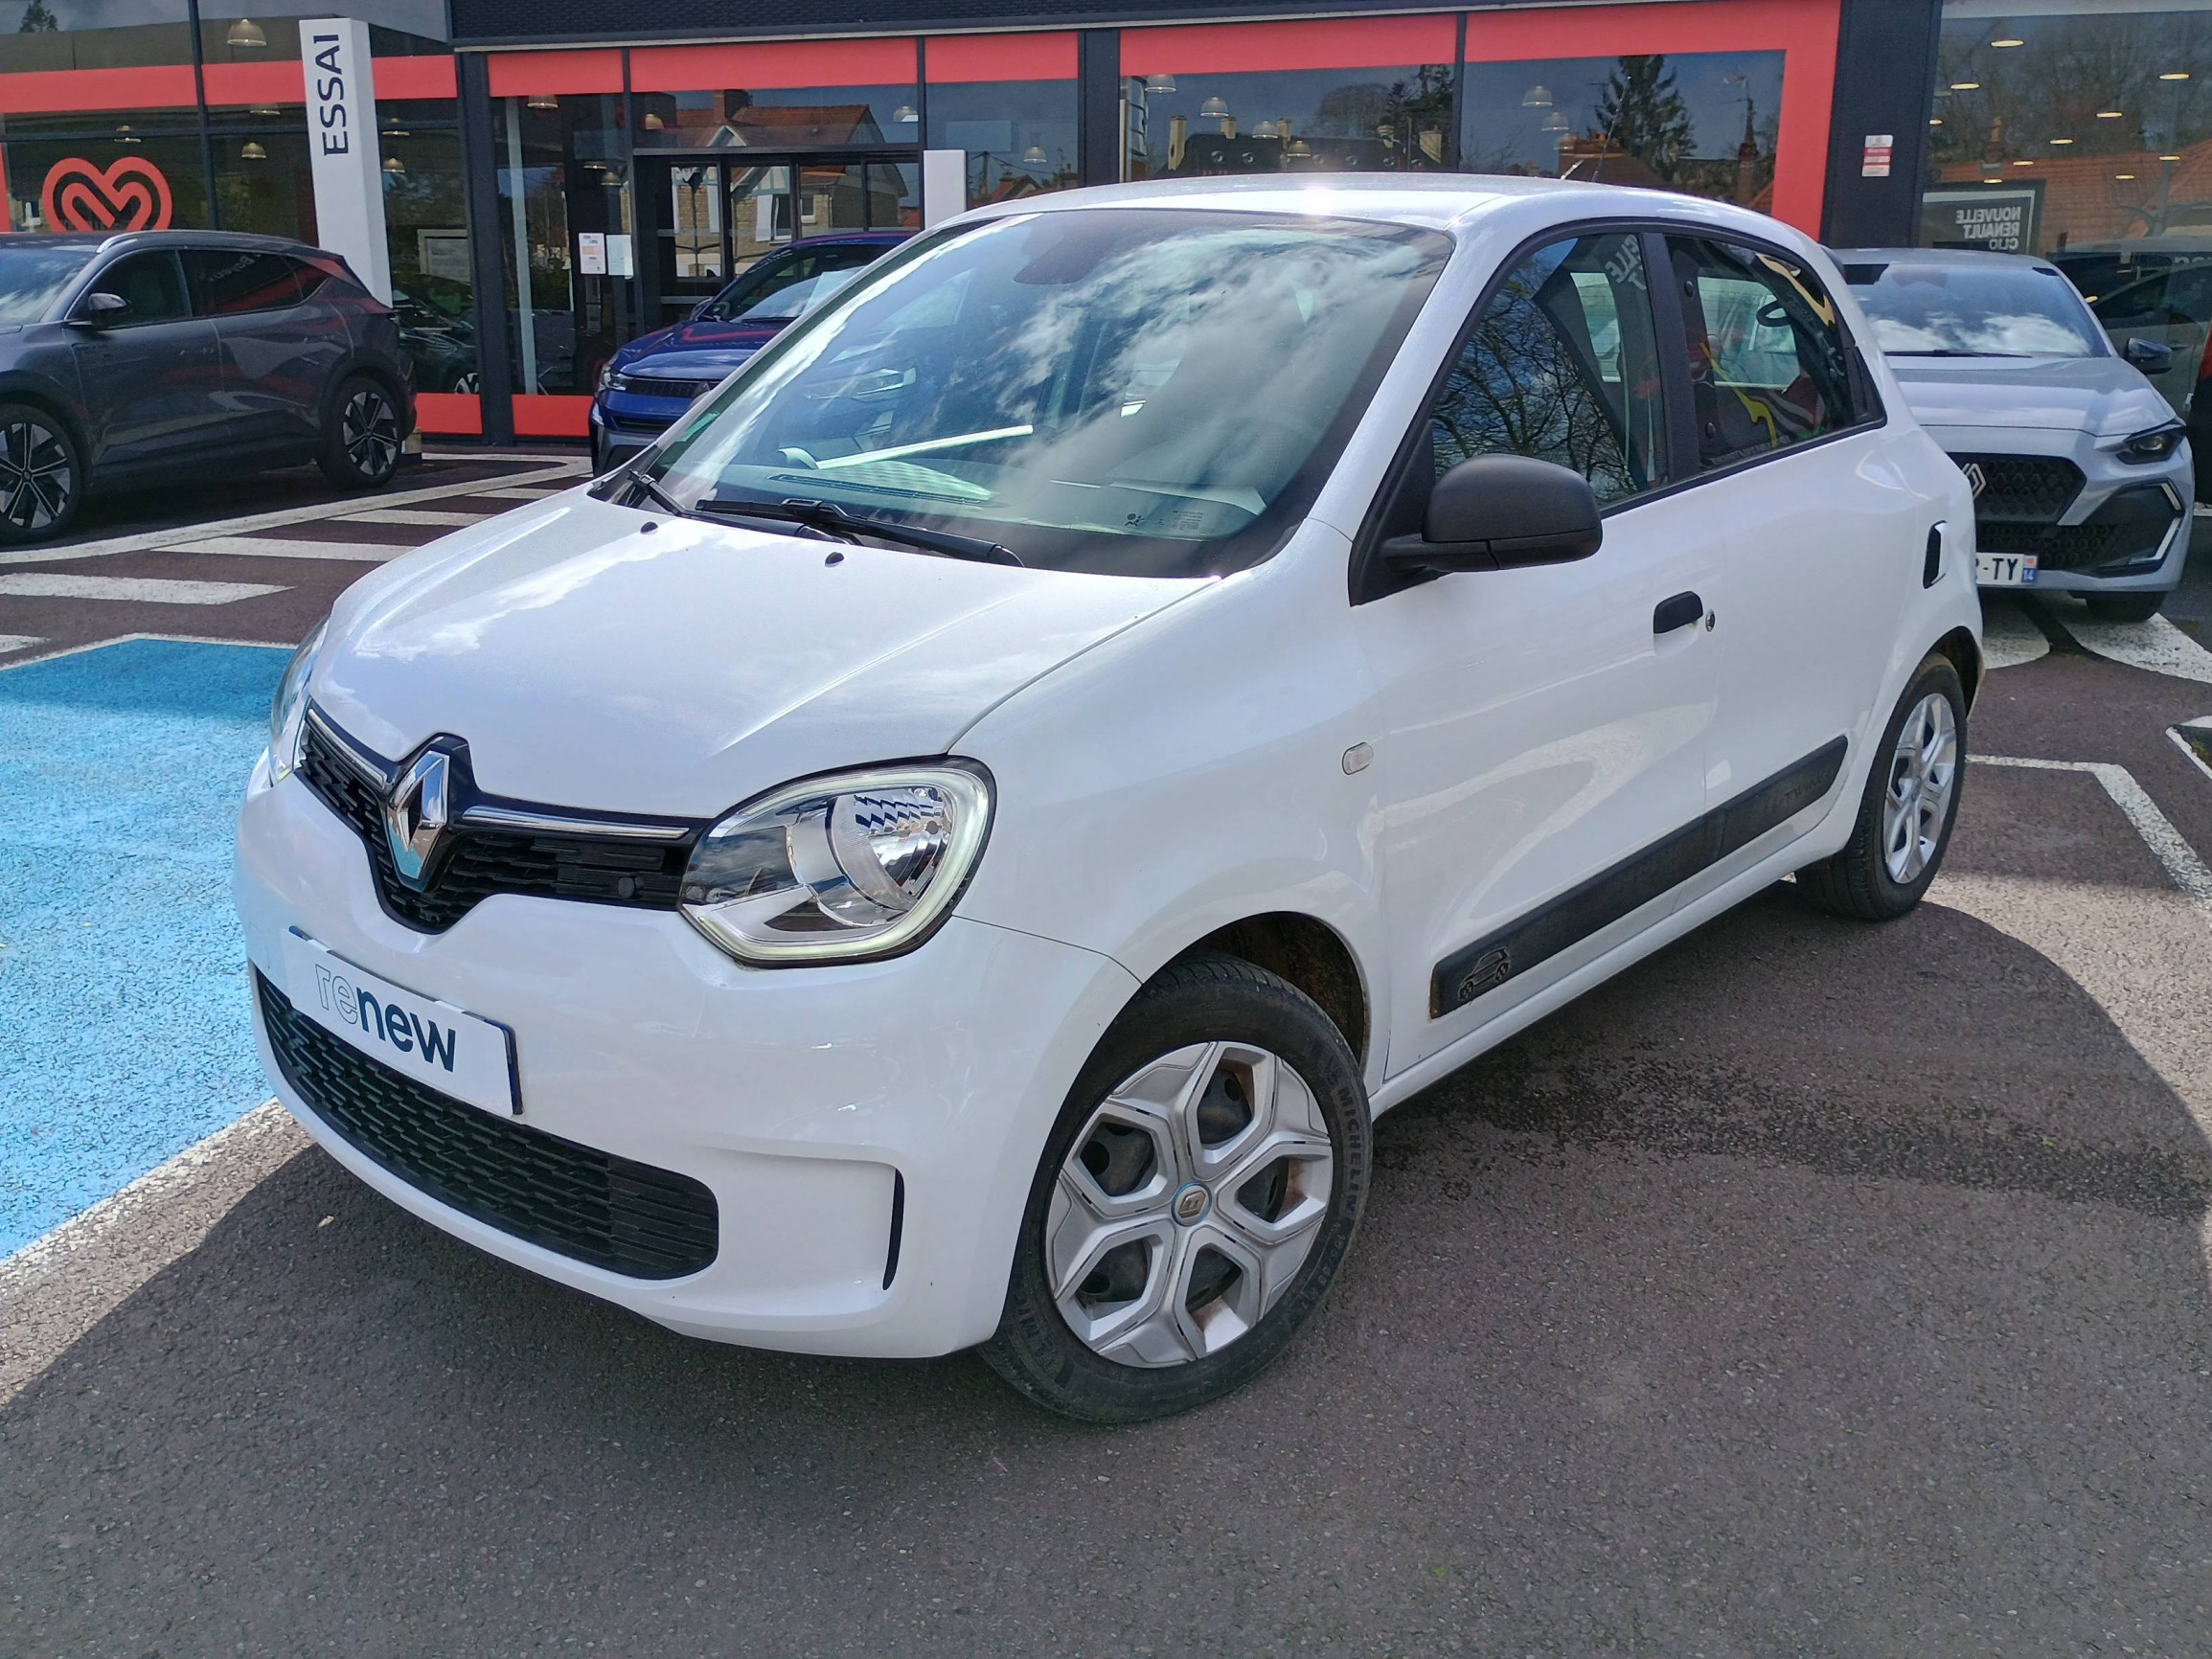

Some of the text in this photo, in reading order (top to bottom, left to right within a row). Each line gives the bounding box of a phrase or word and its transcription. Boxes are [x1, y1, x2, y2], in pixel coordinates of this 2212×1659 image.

[312, 34, 349, 156] ESSAI
[315, 964, 456, 1073] renew
[1337, 1085, 1363, 1215] MICHELIN
